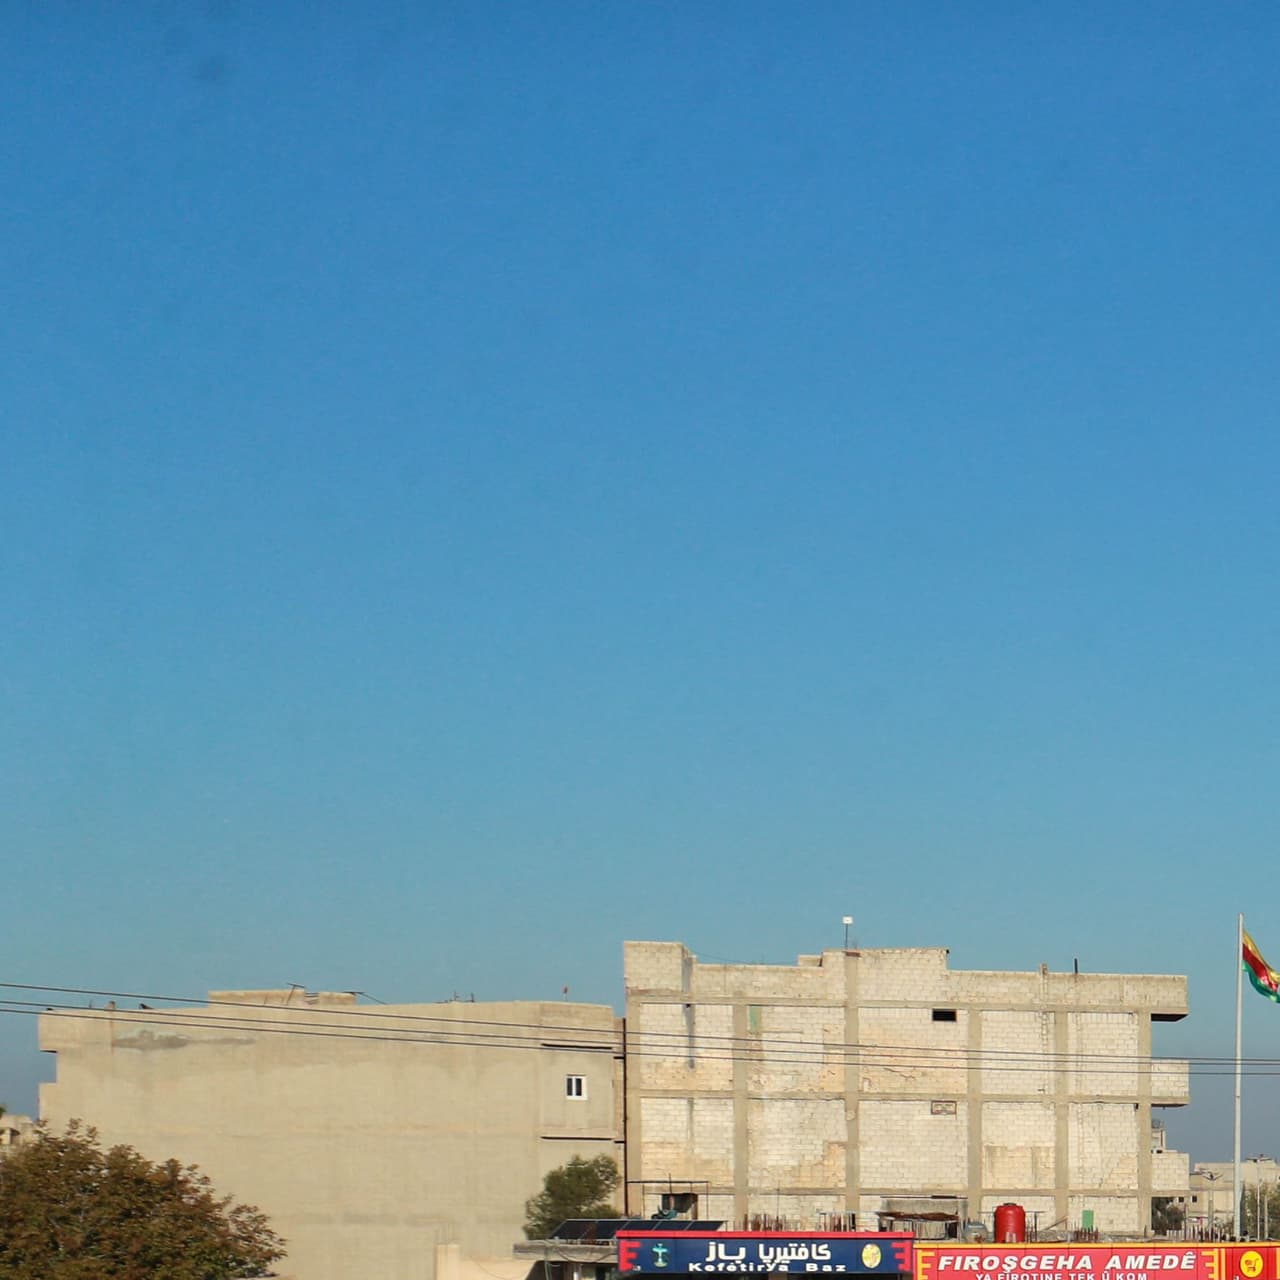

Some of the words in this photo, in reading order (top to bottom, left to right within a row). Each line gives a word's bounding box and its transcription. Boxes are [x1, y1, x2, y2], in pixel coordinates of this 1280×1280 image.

[758, 1243, 832, 1264] كافتيريا
[938, 1255, 1093, 1274] FIROŞGEHA
[1104, 1251, 1197, 1270] AMEDÊ
[805, 1262, 846, 1272] Baz
